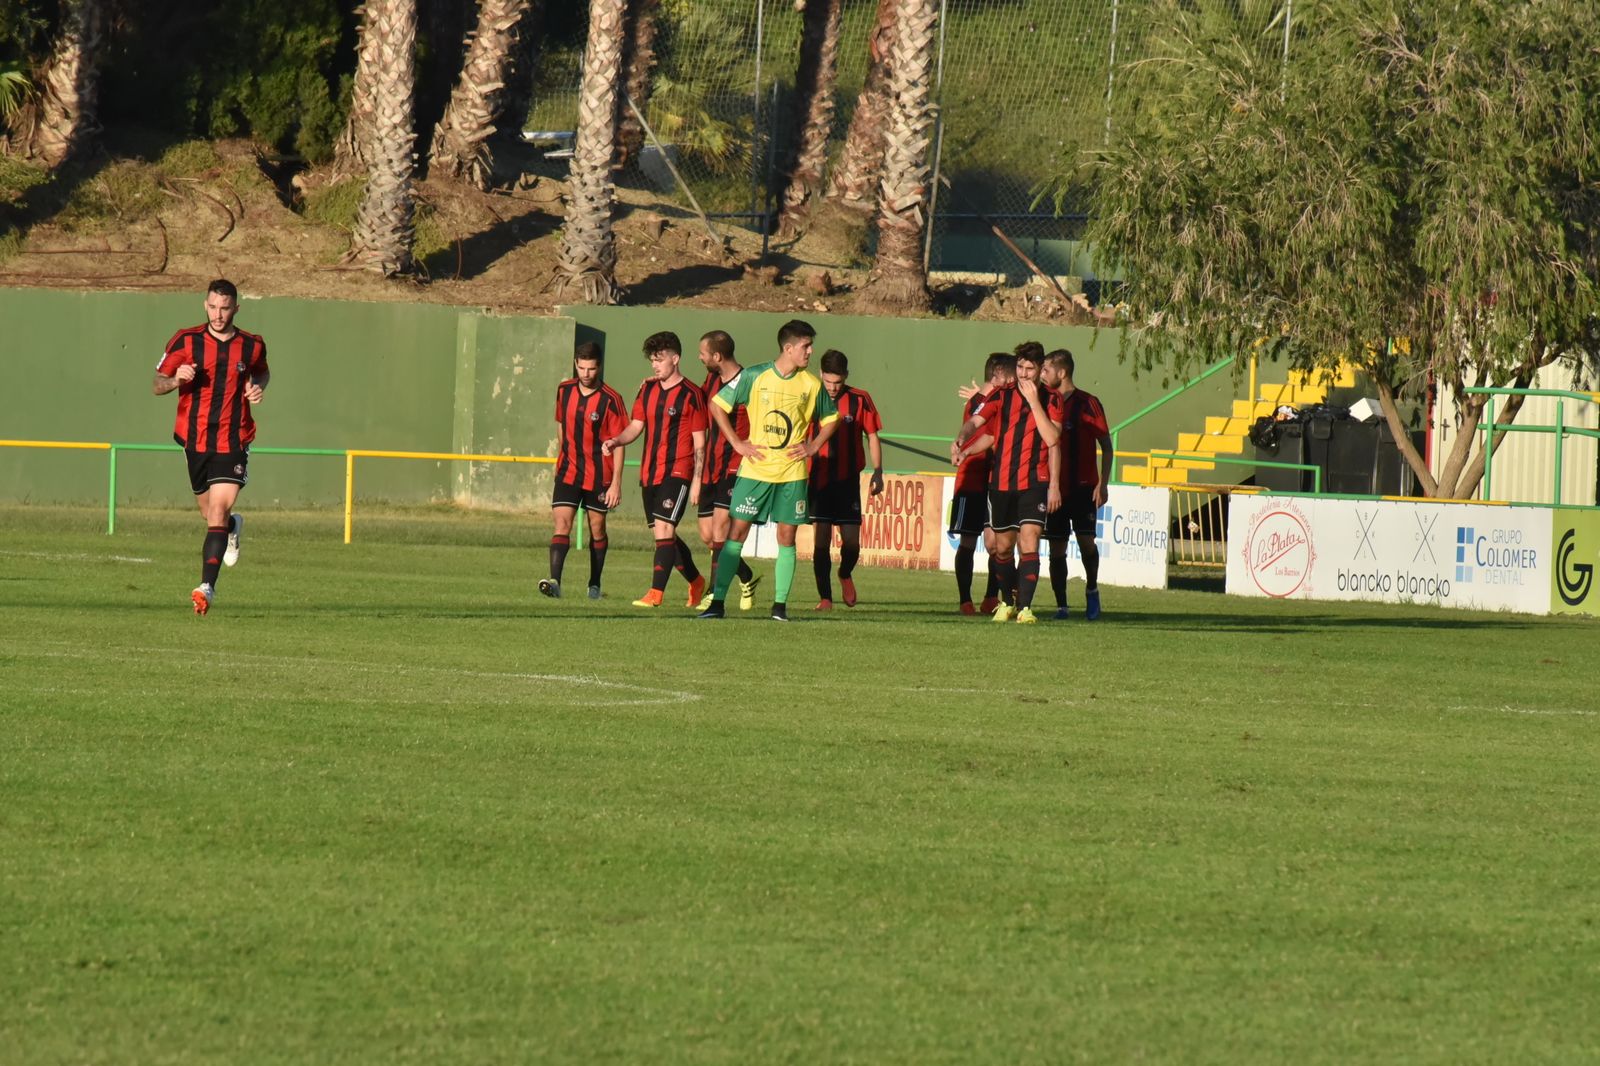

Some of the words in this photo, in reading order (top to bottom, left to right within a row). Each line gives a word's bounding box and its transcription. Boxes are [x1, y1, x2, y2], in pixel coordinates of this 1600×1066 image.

[865, 480, 925, 516] ASADOR
[1128, 509, 1156, 525] GRUPO
[861, 514, 924, 552] MANOLO
[1113, 514, 1168, 550] COLOMER
[1491, 529, 1523, 545] GRUPO
[1120, 546, 1157, 565] DENTAL
[1476, 535, 1537, 569] COLOMER
[1337, 568, 1391, 593] blancko
[1397, 569, 1451, 597] blancko
[1485, 569, 1526, 586] DENTAL
